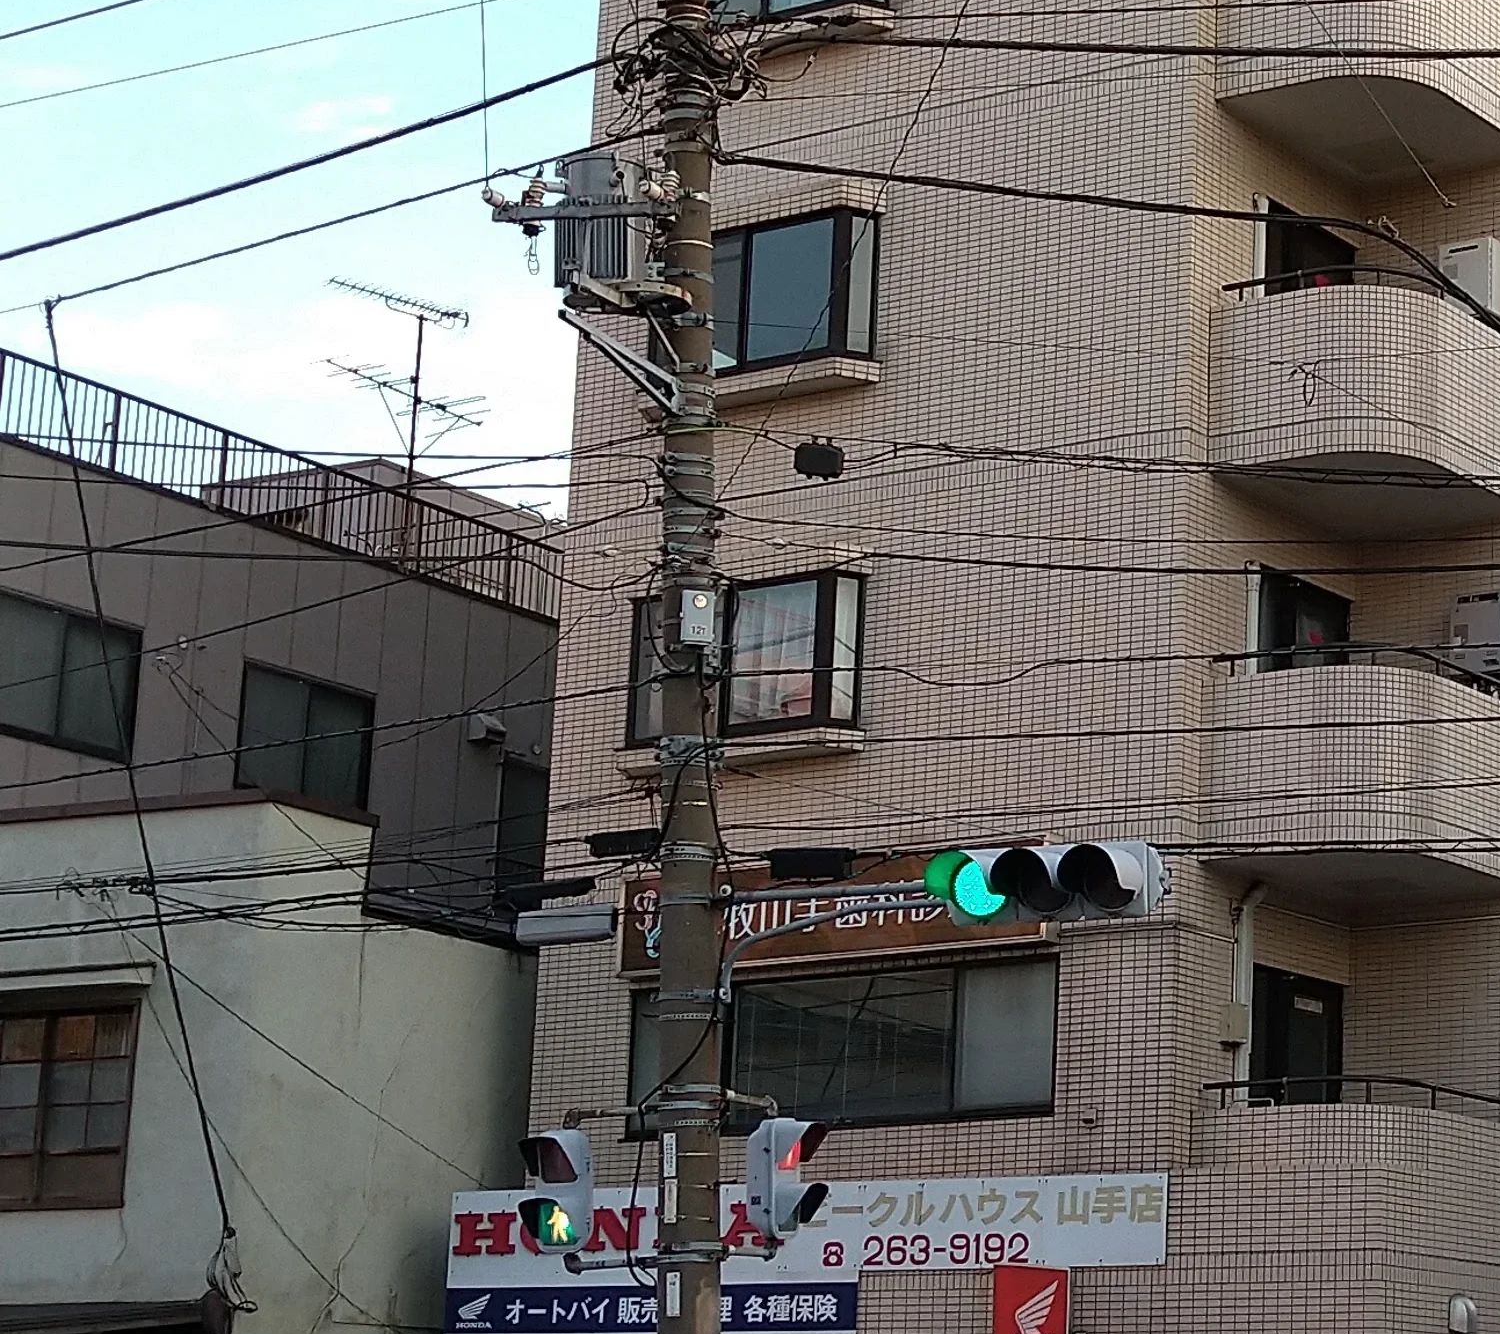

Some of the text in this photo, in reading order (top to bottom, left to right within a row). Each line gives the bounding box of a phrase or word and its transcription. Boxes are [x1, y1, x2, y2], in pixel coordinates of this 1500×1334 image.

[1056, 1184, 1163, 1226] 山手店
[453, 1200, 784, 1257] HNA
[863, 1232, 1030, 1266] 263-9192
[455, 1321, 493, 1330] HONDA
[505, 1296, 610, 1325] オートバイ
[743, 1293, 838, 1324] 各種保険
